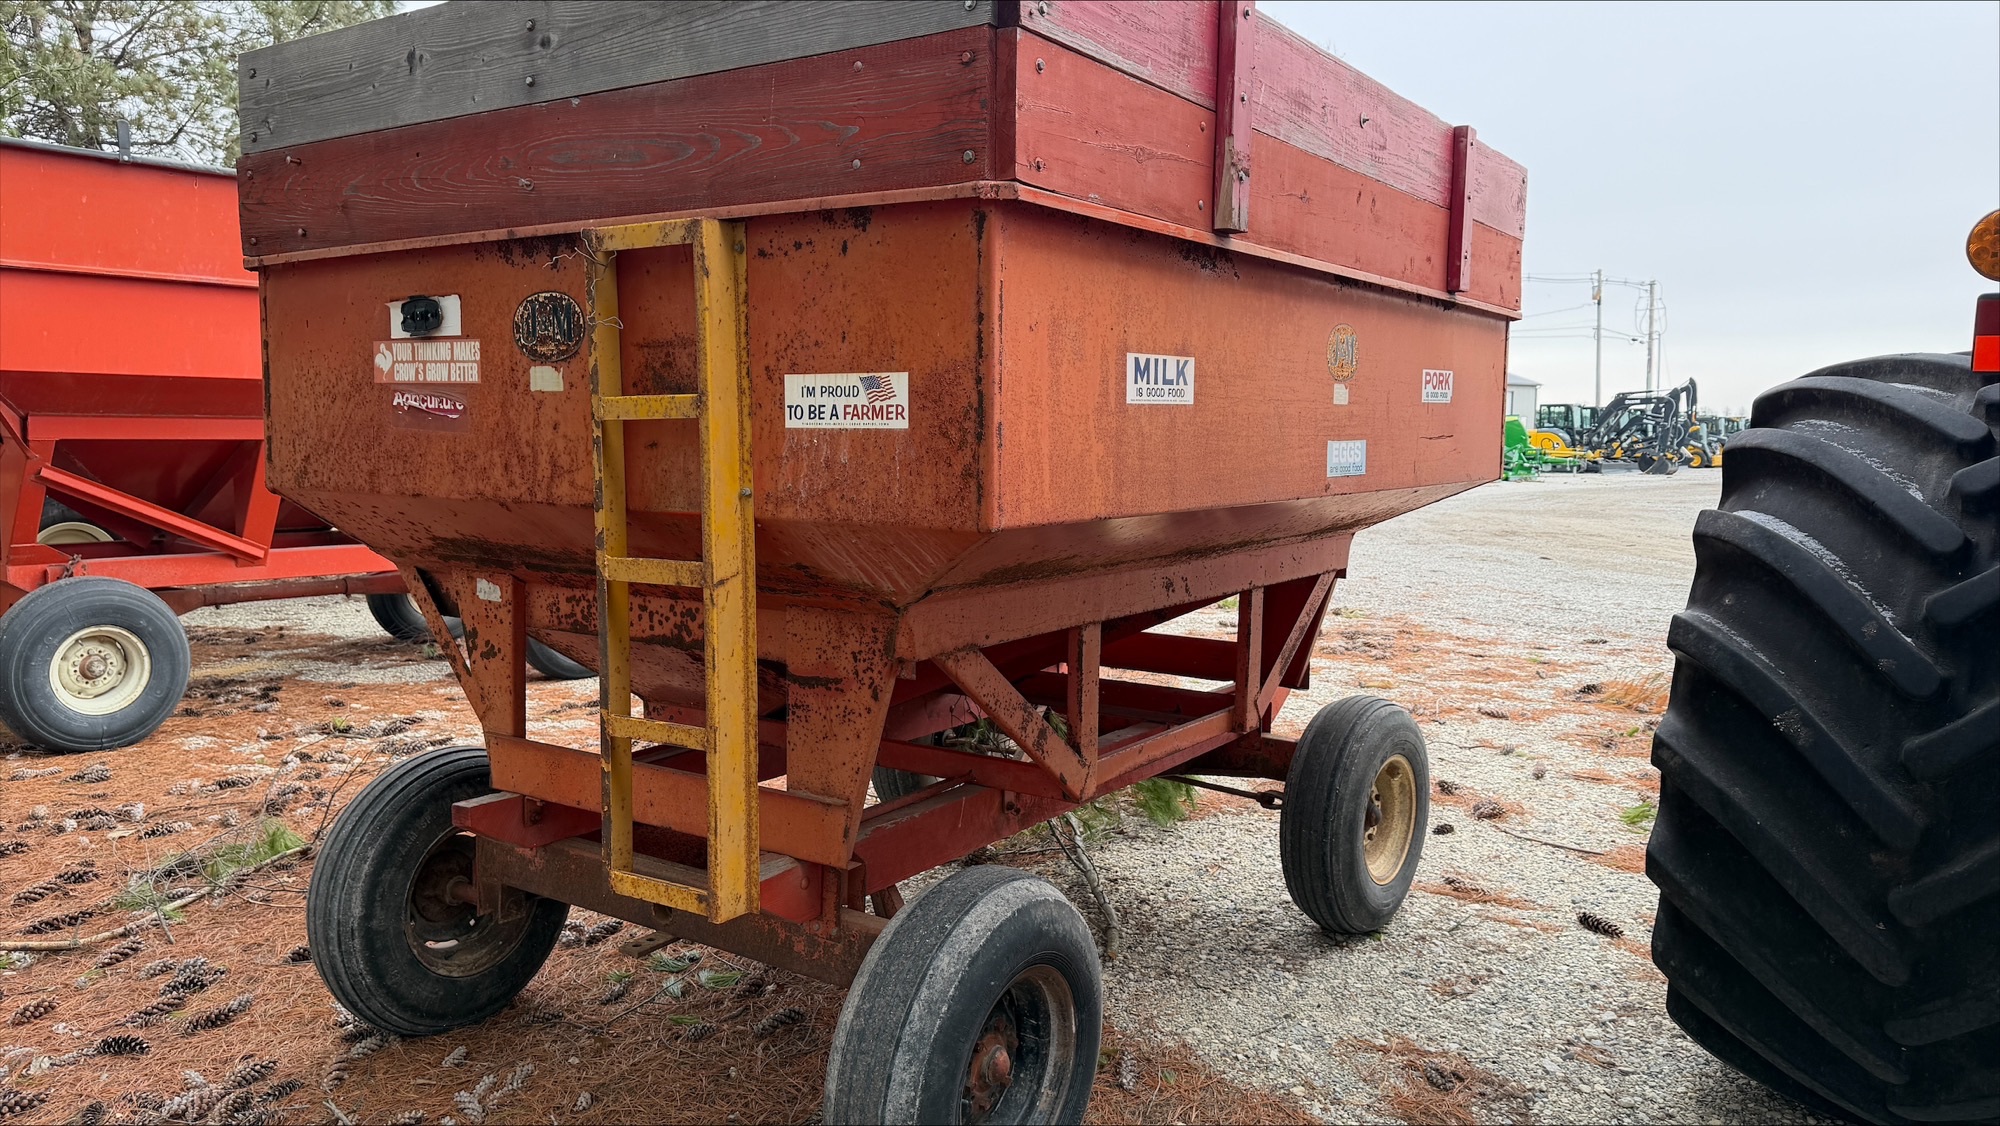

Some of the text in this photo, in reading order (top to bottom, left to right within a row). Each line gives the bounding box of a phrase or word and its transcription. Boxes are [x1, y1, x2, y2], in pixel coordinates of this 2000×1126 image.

[392, 340, 480, 361] YOUR THINKING MAKES
[394, 361, 478, 382] CROW'S GROW BETTER
[1133, 356, 1190, 386] MILK
[1424, 371, 1451, 390] PORK
[801, 384, 860, 398] I'M PROUD
[1135, 387, 1186, 398] IS GOOD FOOD
[787, 403, 906, 421] TO BE A FARMER
[1333, 442, 1361, 463] EGGS
